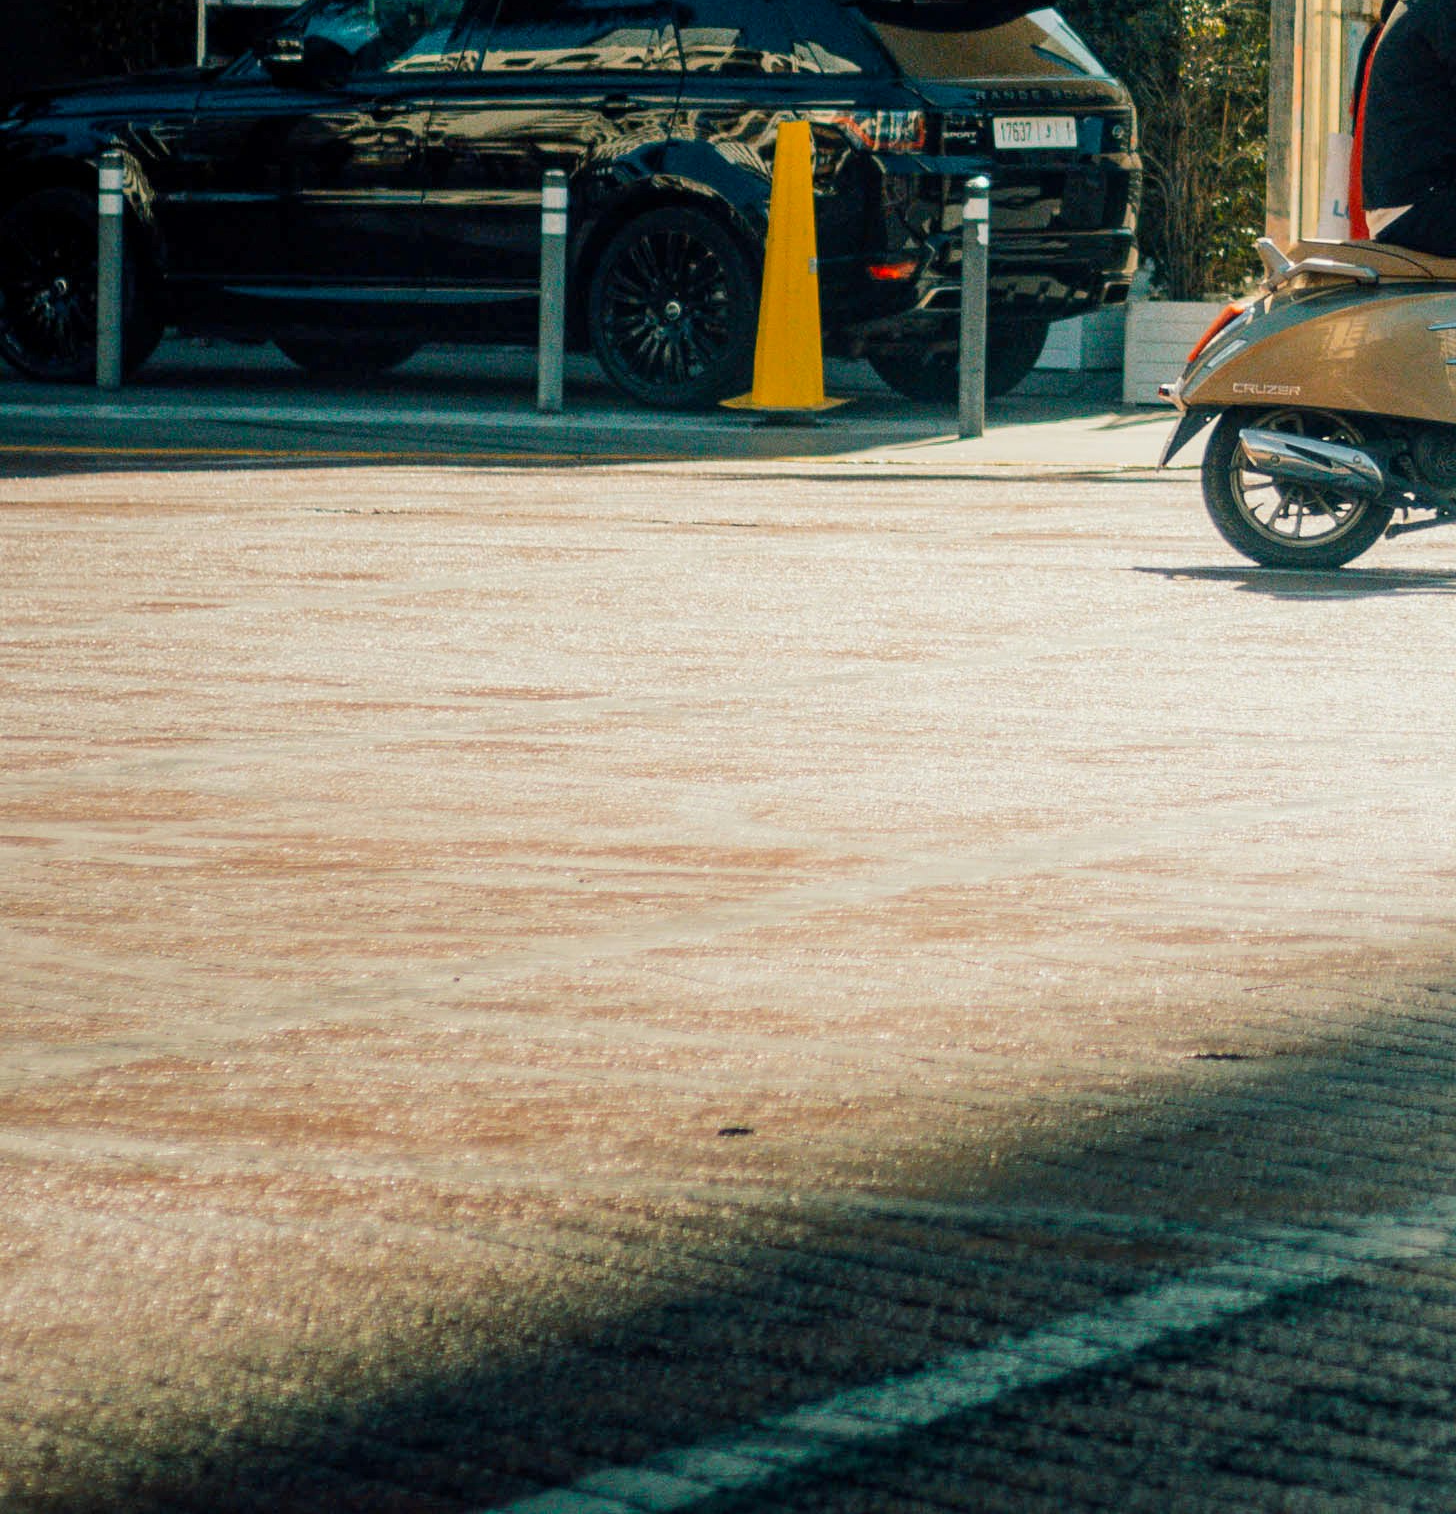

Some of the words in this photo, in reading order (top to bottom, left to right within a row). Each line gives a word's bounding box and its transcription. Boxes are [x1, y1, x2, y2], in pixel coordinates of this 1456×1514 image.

[976, 90, 1040, 100] RANGE
[942, 131, 977, 139] SPORT
[1000, 122, 1031, 142] 17637
[1232, 382, 1301, 396] CRUZER
